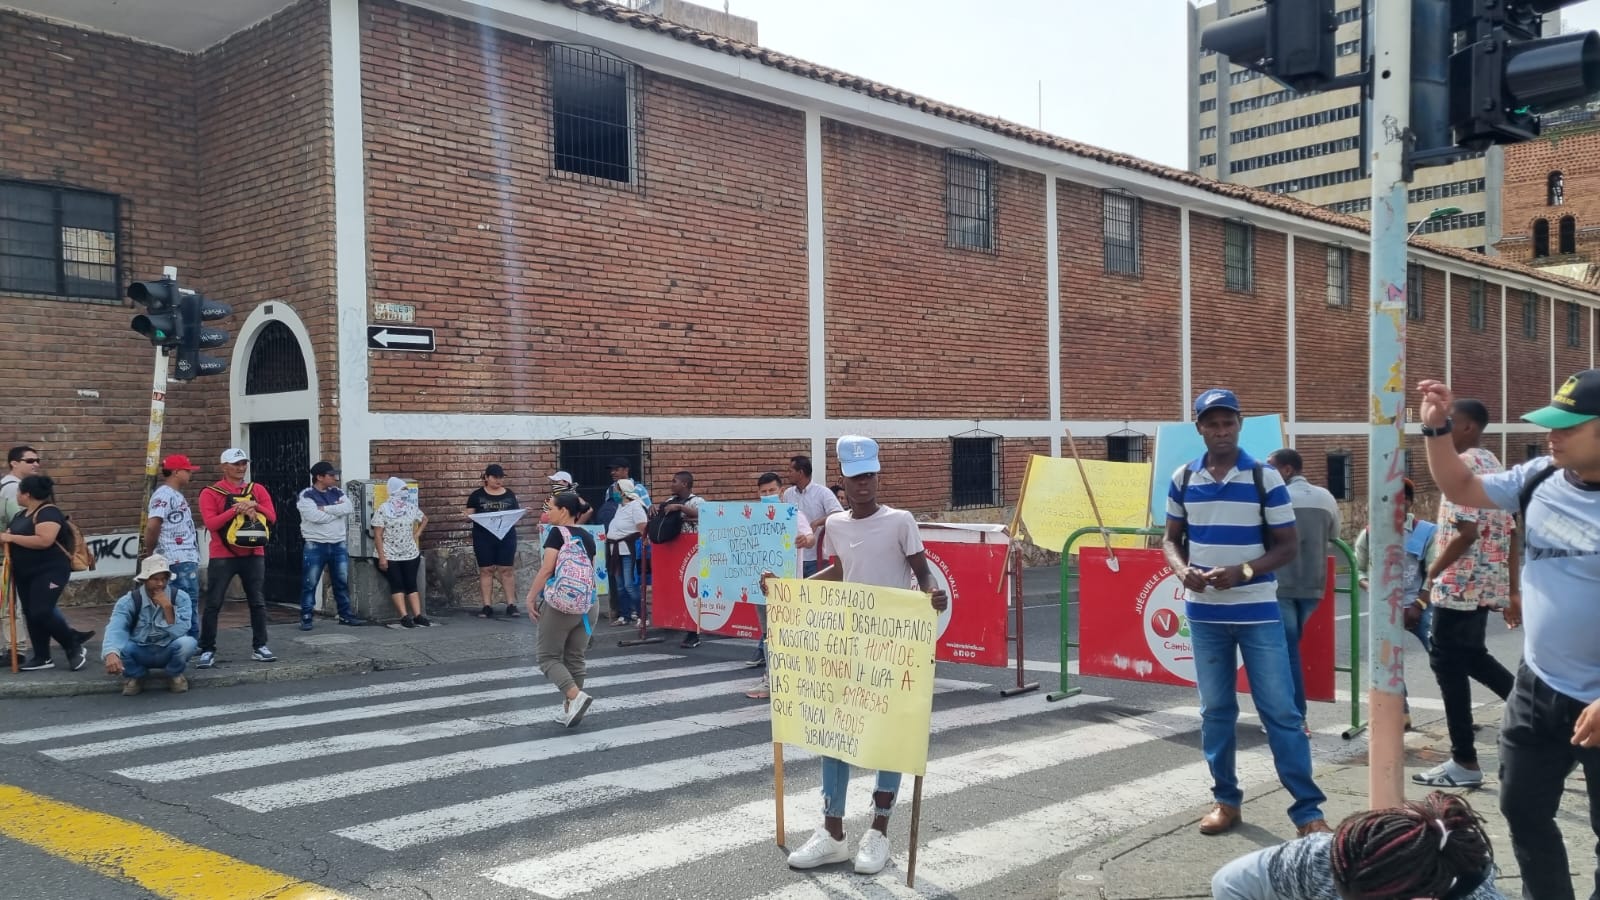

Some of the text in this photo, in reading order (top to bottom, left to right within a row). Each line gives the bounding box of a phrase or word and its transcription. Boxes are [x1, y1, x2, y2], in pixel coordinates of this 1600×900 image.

[729, 537, 760, 553] DIGNA
[747, 522, 787, 537] VIVIENDA
[709, 549, 784, 568] PARA NOSOTROS
[924, 548, 960, 599] ALUD DEL VALLE
[774, 582, 792, 603] NO
[799, 584, 813, 604] AL
[820, 585, 875, 610] DESALOJO
[1135, 574, 1159, 615] JUÉGUELE
[766, 603, 932, 645] PORQUE QUIEREN DESALOJARNOS
[766, 627, 774, 648] A
[778, 626, 820, 652] NOSOTROS
[824, 633, 860, 657] GENTE
[1163, 641, 1192, 652] Cambi
[767, 650, 916, 692] PORQUE NO PONEN LA LUPA A
[771, 674, 889, 714] LAS GRANDES EMPRESAS
[773, 698, 793, 717] QUE
[798, 702, 826, 725] TIENEN
[804, 725, 859, 758] SUBNORMALES
